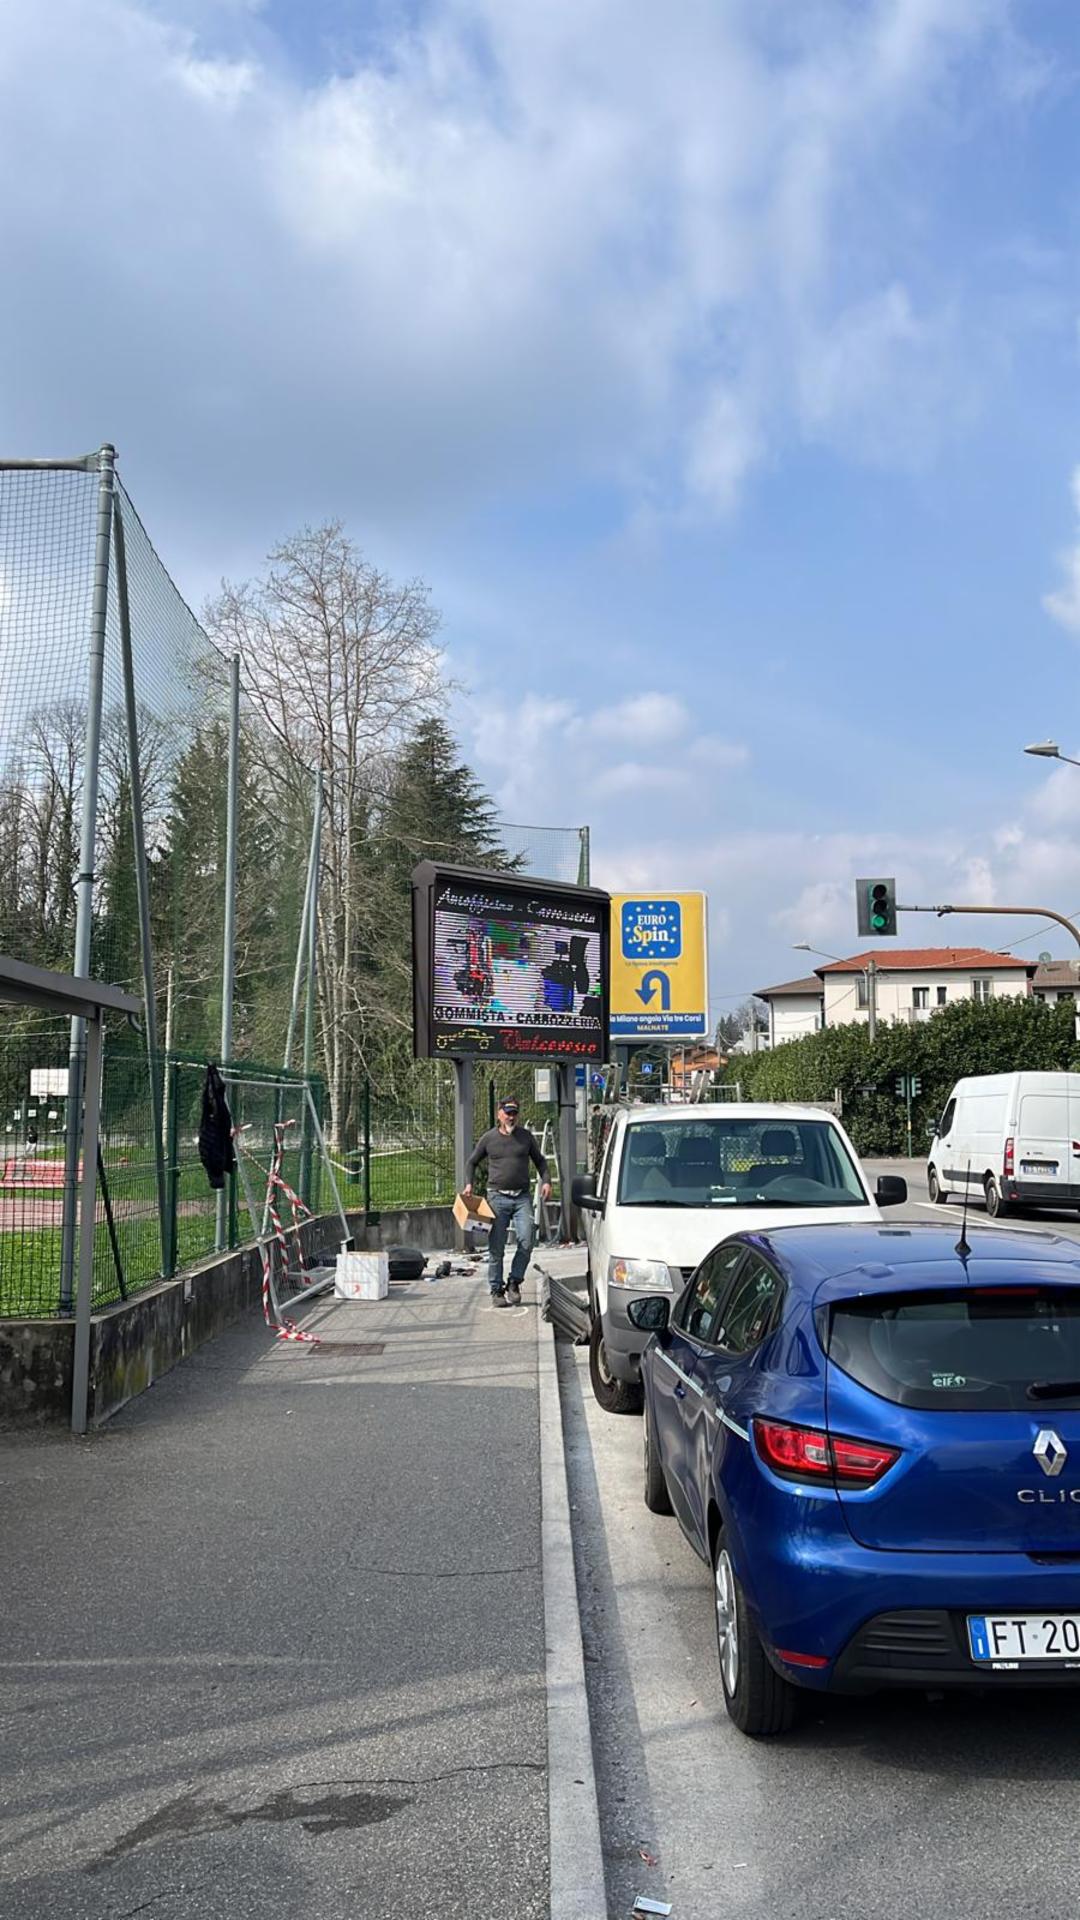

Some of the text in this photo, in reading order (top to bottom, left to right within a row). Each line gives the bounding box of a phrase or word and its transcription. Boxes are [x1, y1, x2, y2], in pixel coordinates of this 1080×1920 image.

[637, 914, 666, 925] EURO
[633, 925, 669, 946] Spin
[433, 1006, 504, 1023] GOMMISTA
[516, 1013, 602, 1030] CARROZZERIA
[639, 1015, 662, 1024] angolo
